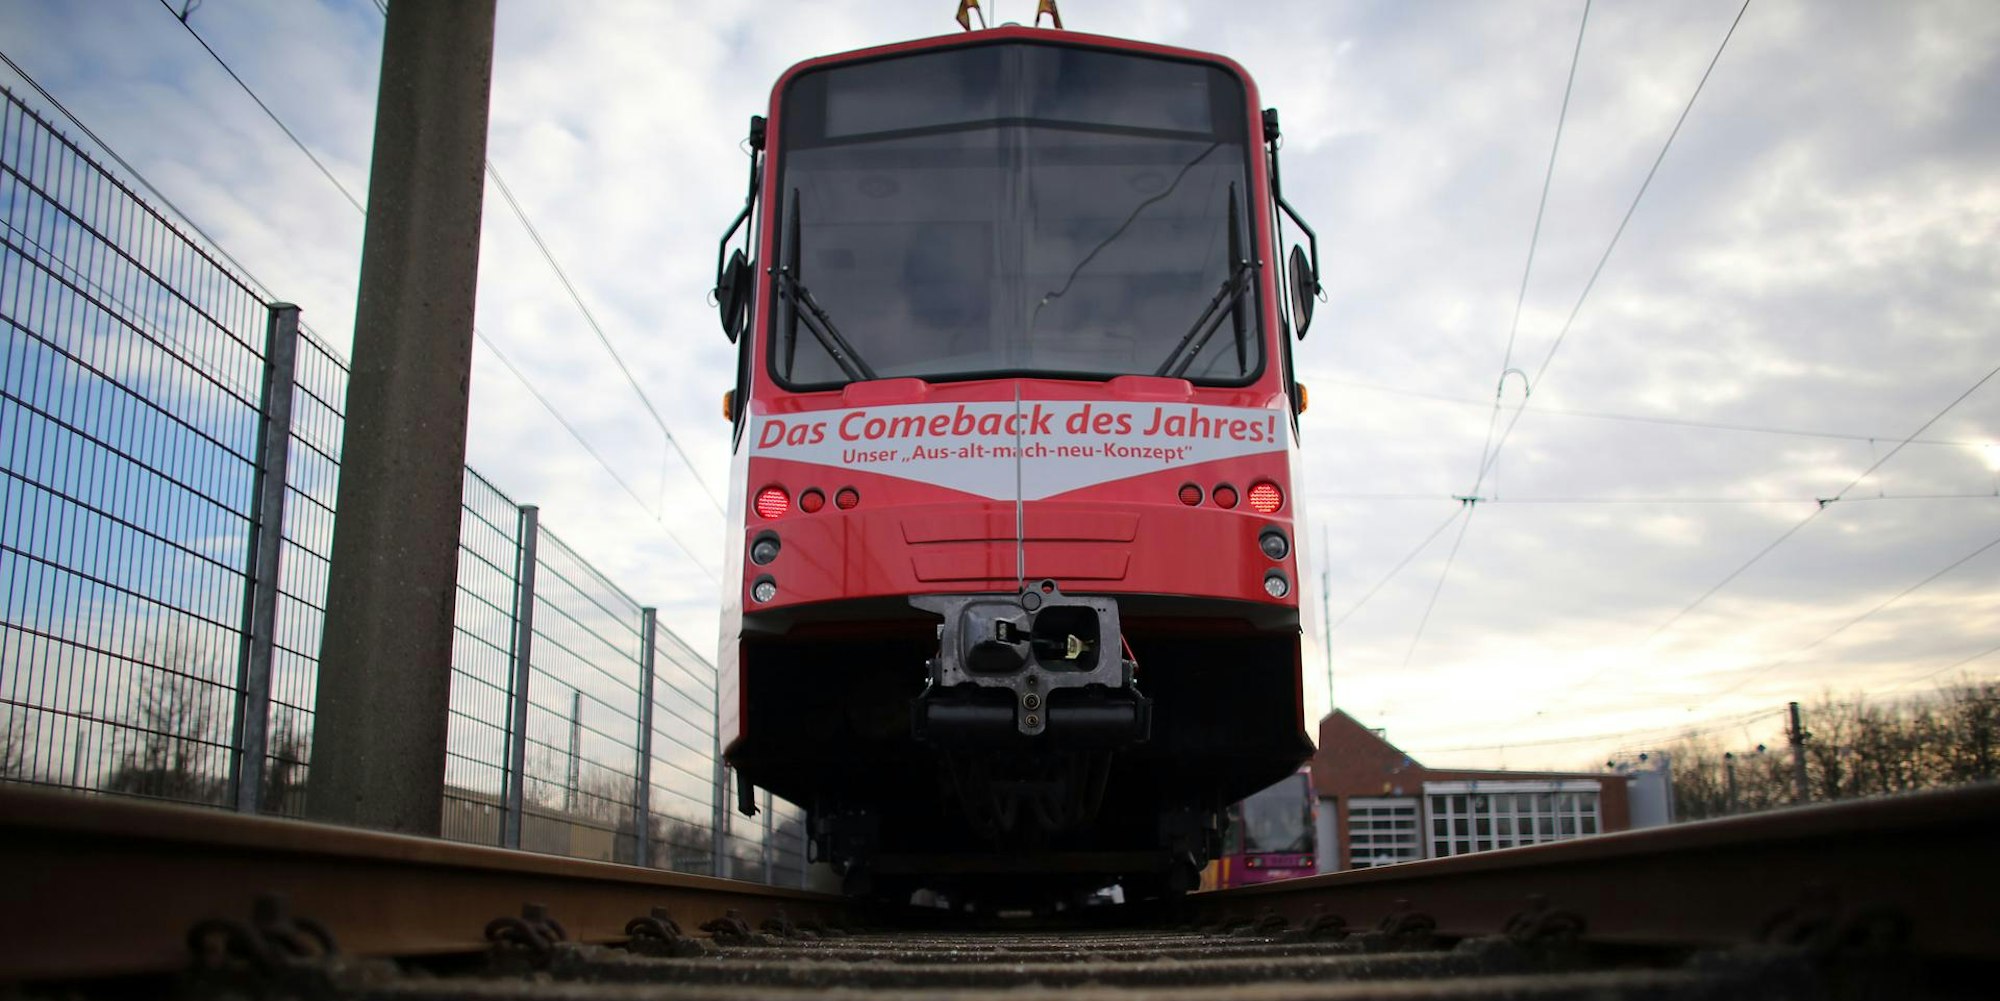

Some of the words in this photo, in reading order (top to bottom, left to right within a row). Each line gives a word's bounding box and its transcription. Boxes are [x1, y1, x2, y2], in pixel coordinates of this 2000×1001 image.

[757, 419, 826, 449] Das
[838, 403, 1053, 442] Comeback
[1065, 404, 1132, 436] des
[1142, 407, 1276, 443] Jahres!
[841, 447, 898, 464] Unser
